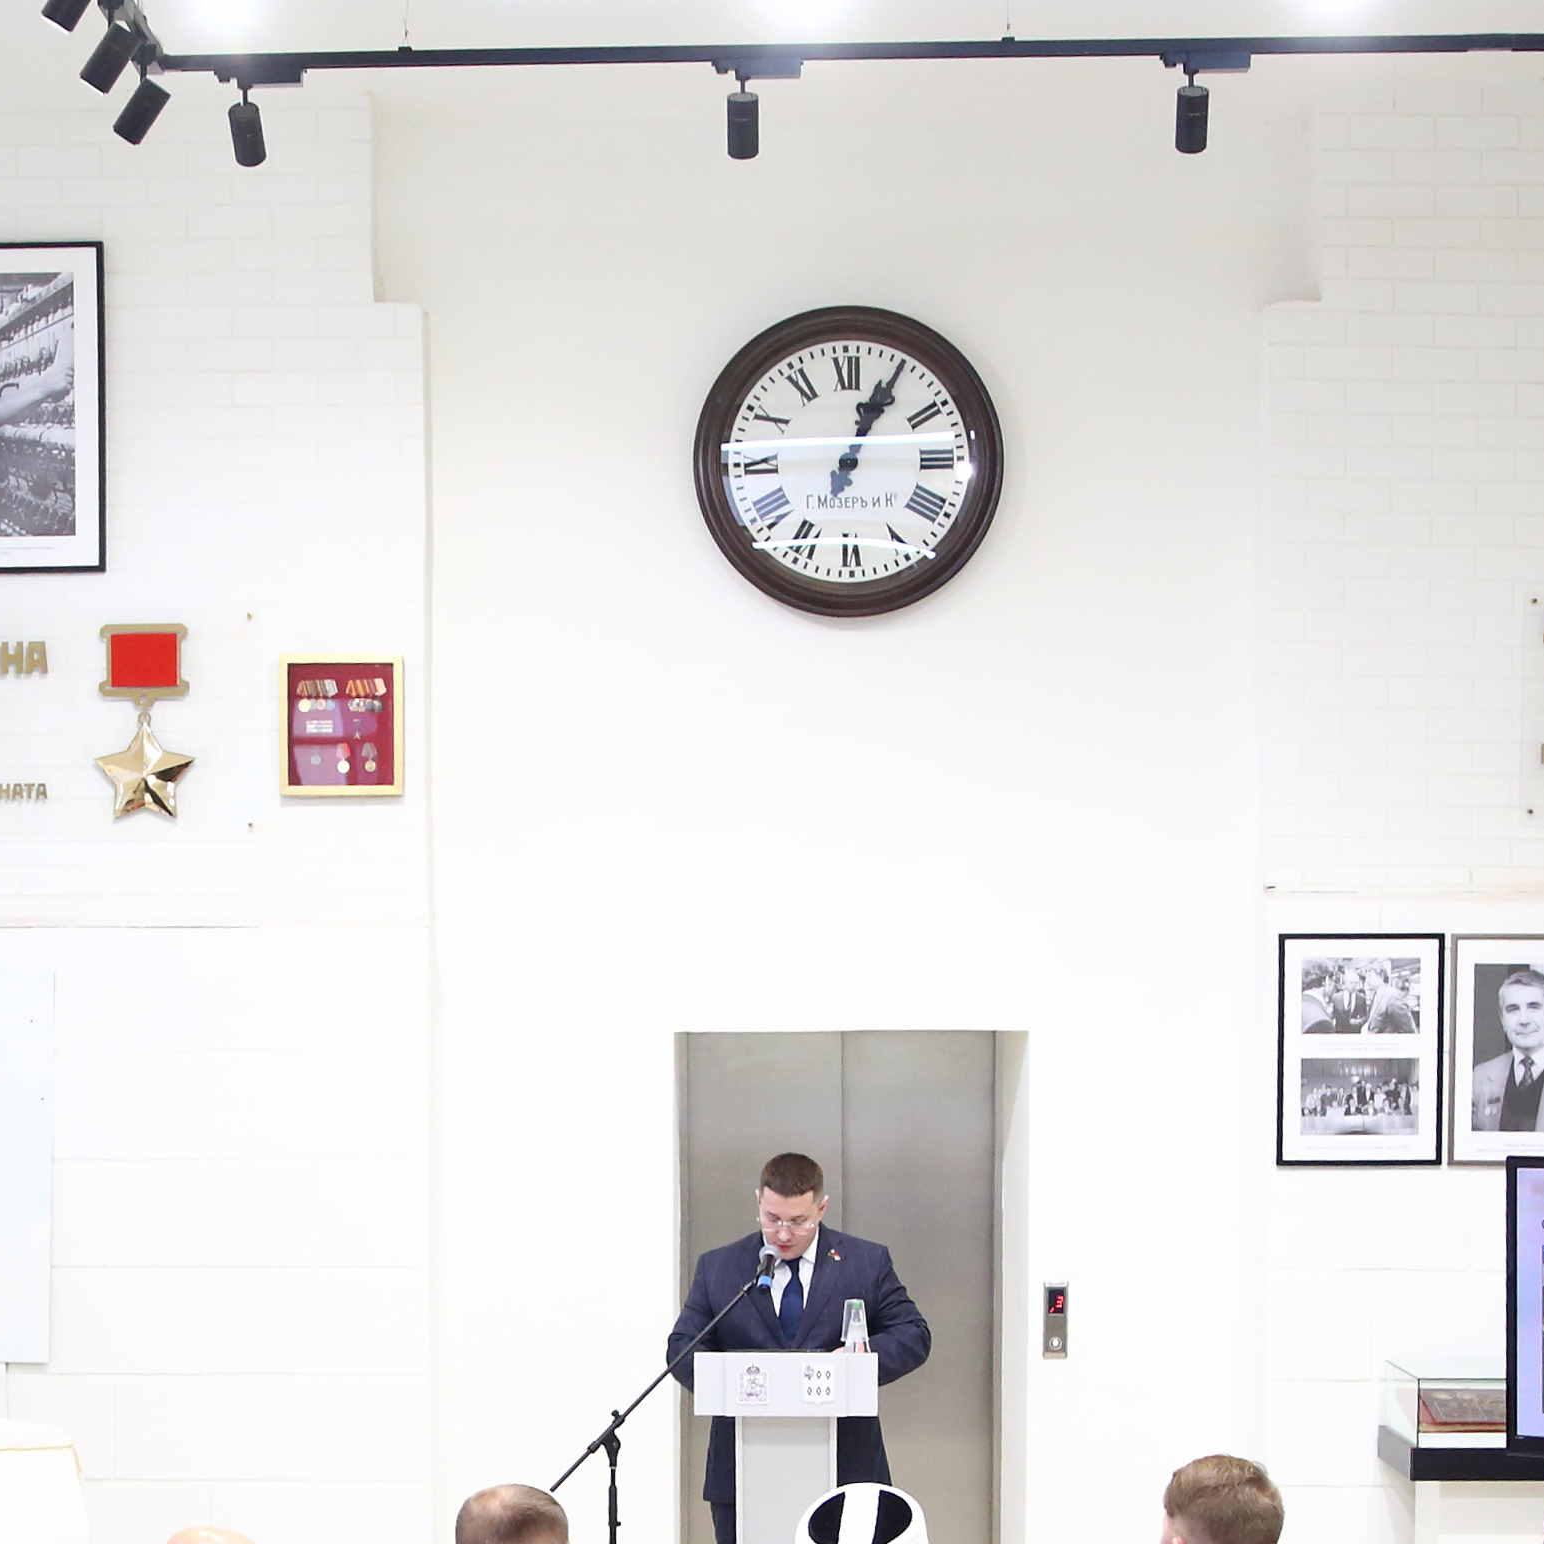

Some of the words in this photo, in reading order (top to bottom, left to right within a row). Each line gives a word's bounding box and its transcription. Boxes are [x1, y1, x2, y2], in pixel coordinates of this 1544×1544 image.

[785, 366, 819, 407] XI
[832, 355, 861, 391] XII
[907, 401, 942, 430] II
[919, 448, 954, 471] III
